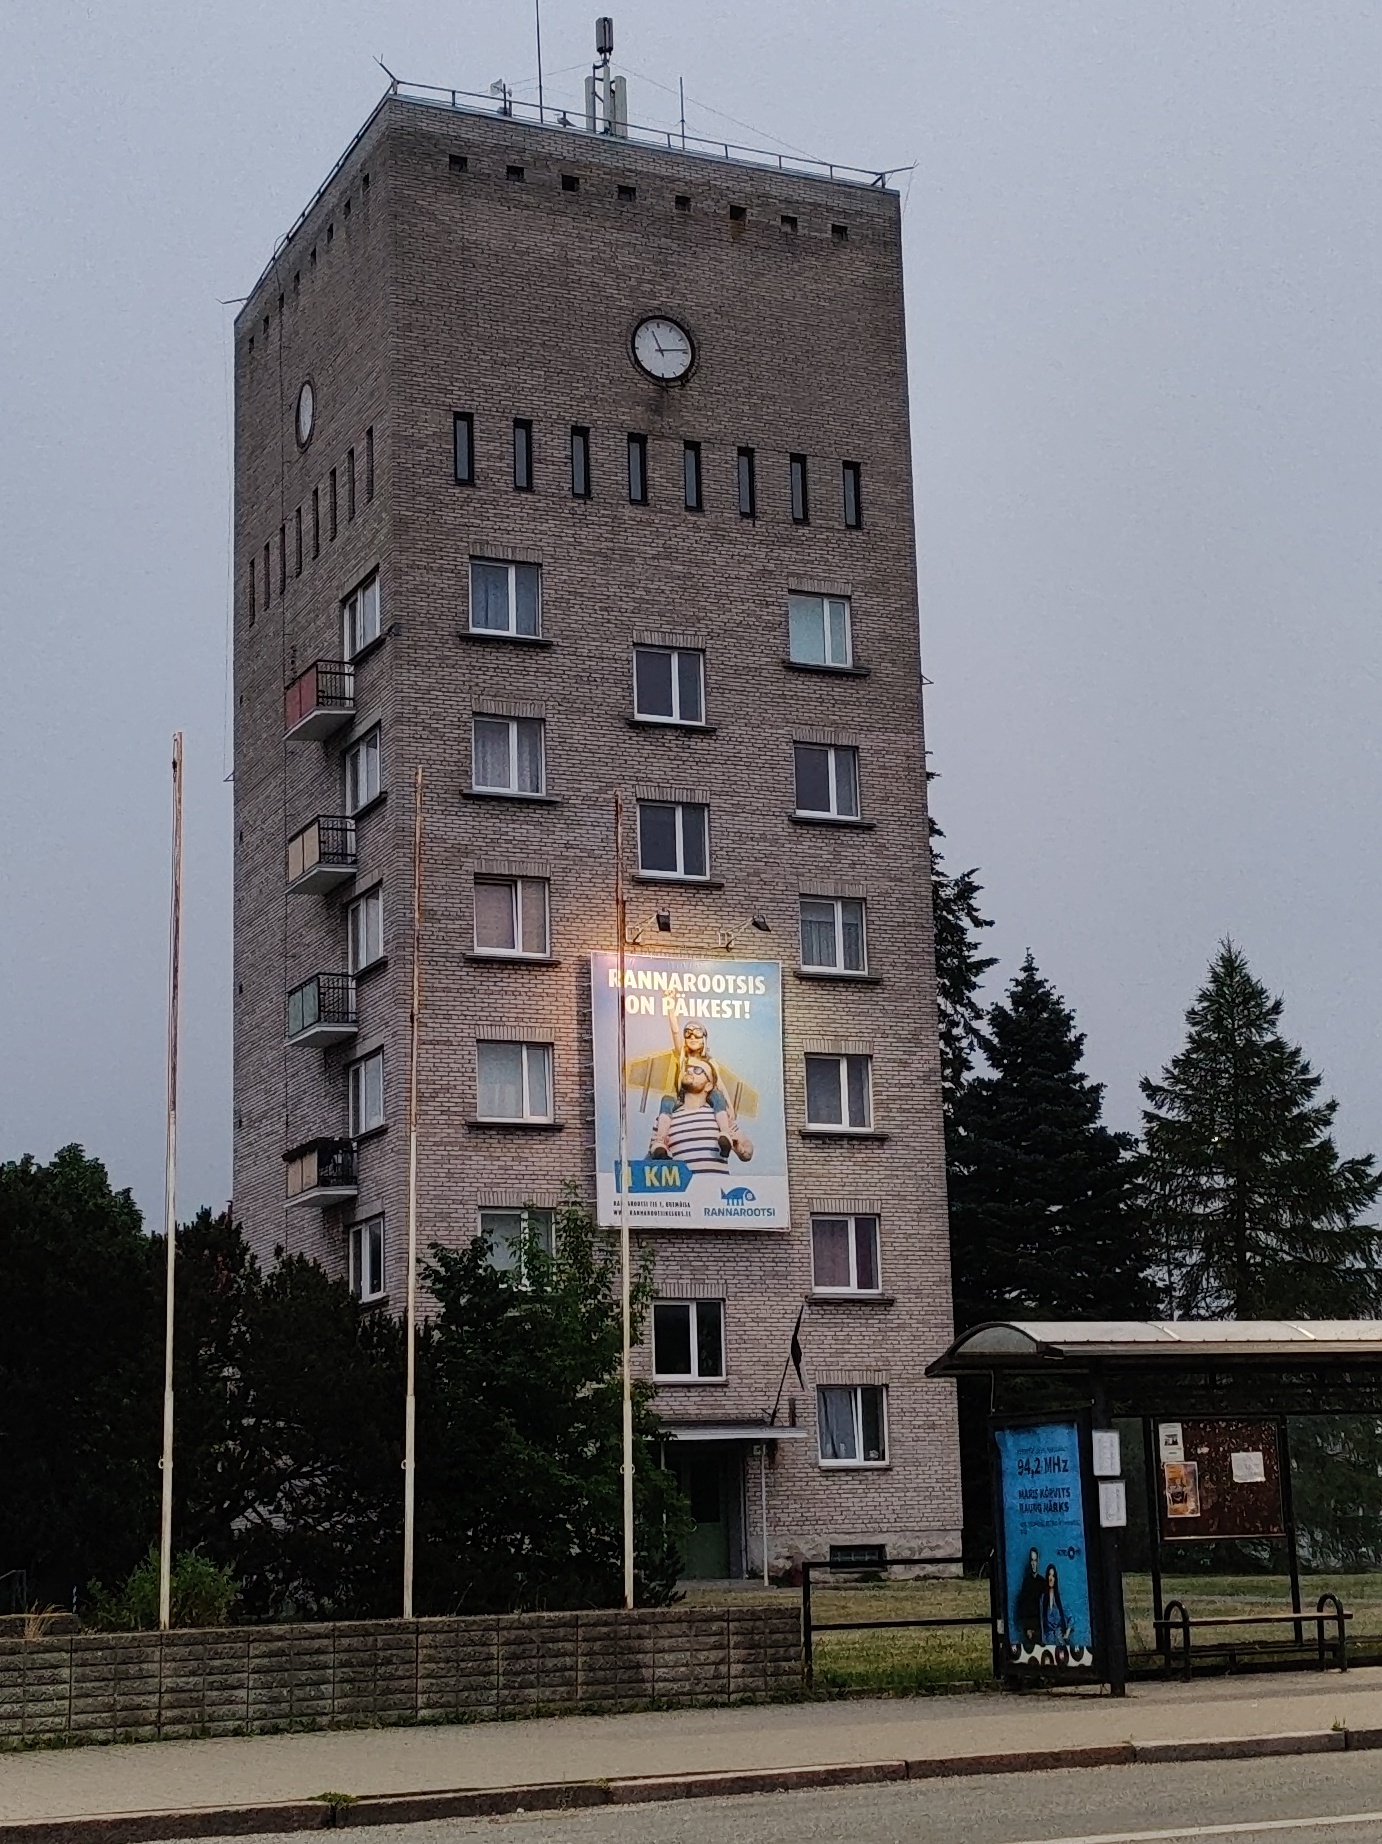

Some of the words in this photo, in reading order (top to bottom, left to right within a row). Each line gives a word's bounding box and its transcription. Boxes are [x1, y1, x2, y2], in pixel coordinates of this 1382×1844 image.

[608, 968, 766, 995] RANNAROOTSIS
[625, 994, 655, 1015] ON
[662, 993, 751, 1019] PÄIKEST!
[644, 1165, 681, 1187] KM
[703, 1207, 776, 1218] RANNAROOTSI
[1017, 1457, 1041, 1478] 94,2
[1044, 1455, 1069, 1474] MHz
